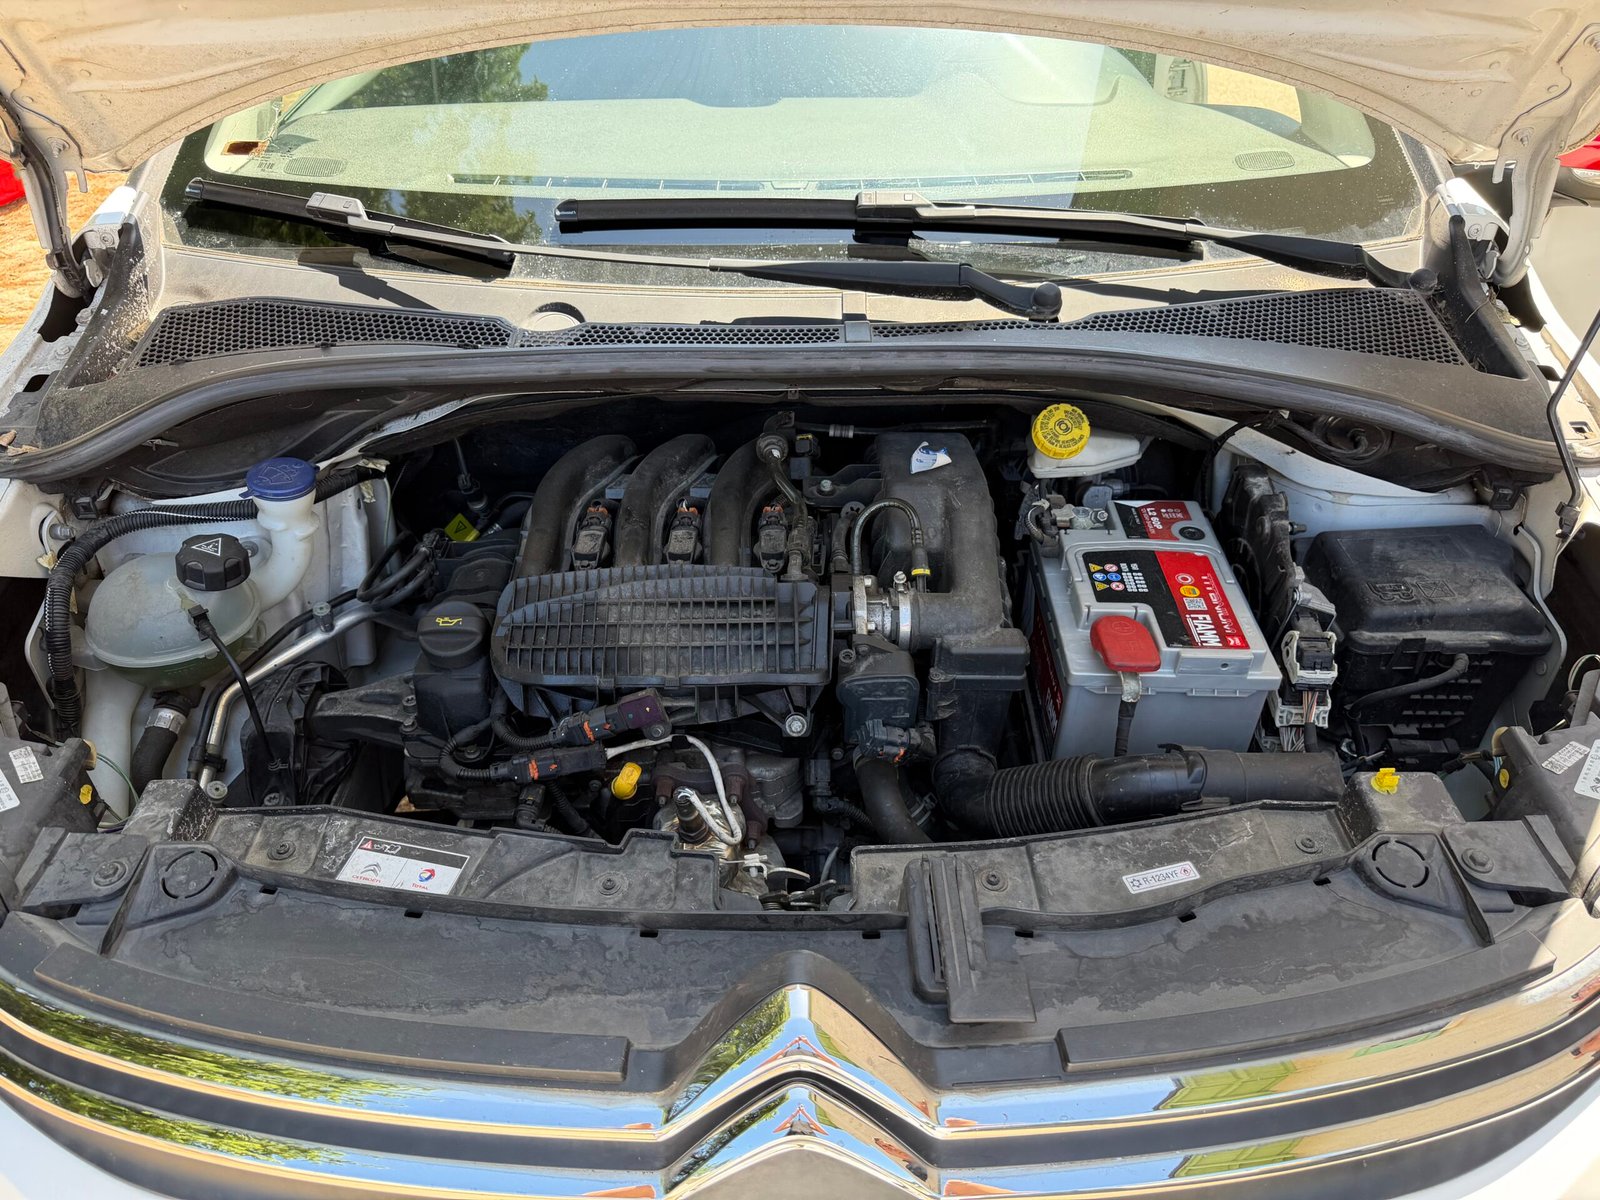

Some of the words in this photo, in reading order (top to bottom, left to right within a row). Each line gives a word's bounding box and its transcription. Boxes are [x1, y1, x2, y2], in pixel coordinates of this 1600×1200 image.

[1190, 614, 1223, 647] FIAMM
[1142, 870, 1179, 884] R-1234YF
[411, 882, 429, 890] TOTAL
